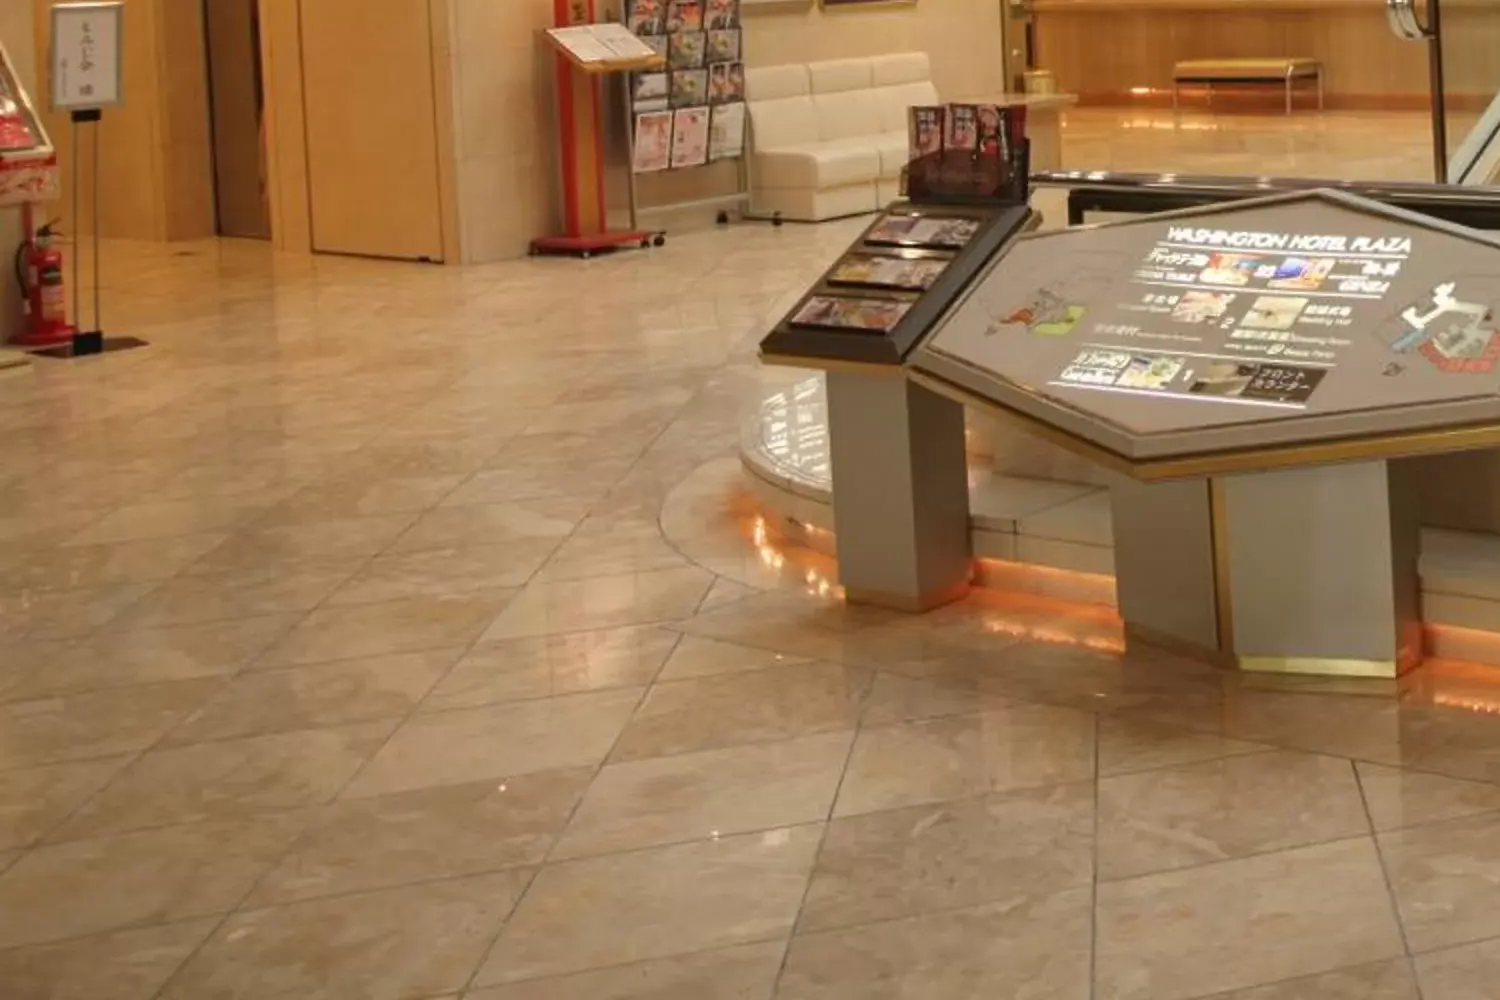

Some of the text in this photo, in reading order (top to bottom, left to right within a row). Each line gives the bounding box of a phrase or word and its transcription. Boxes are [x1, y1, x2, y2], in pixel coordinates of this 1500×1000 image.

[1167, 226, 1412, 253] WASHINGTON HOTEL PLAZA
